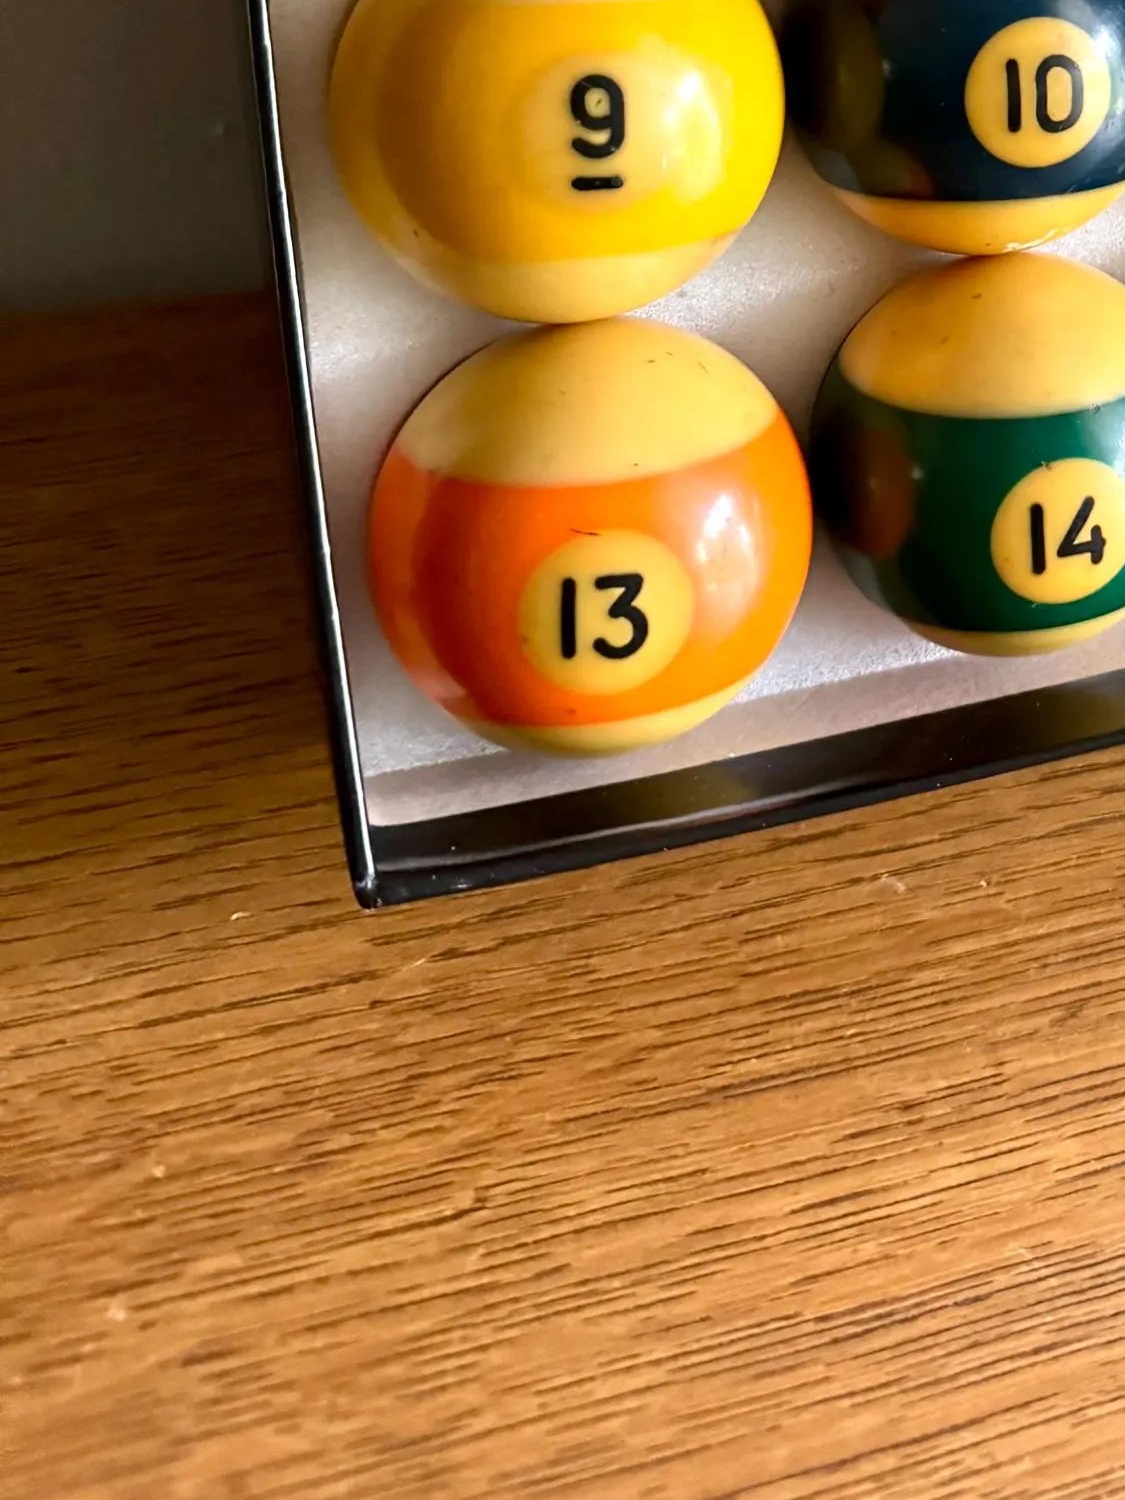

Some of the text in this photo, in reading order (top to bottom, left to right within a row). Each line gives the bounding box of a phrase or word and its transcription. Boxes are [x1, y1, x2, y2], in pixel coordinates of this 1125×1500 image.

[566, 72, 627, 162] 9
[1003, 53, 1081, 135] 10
[1027, 495, 1107, 577] 14
[556, 571, 650, 662] 13
